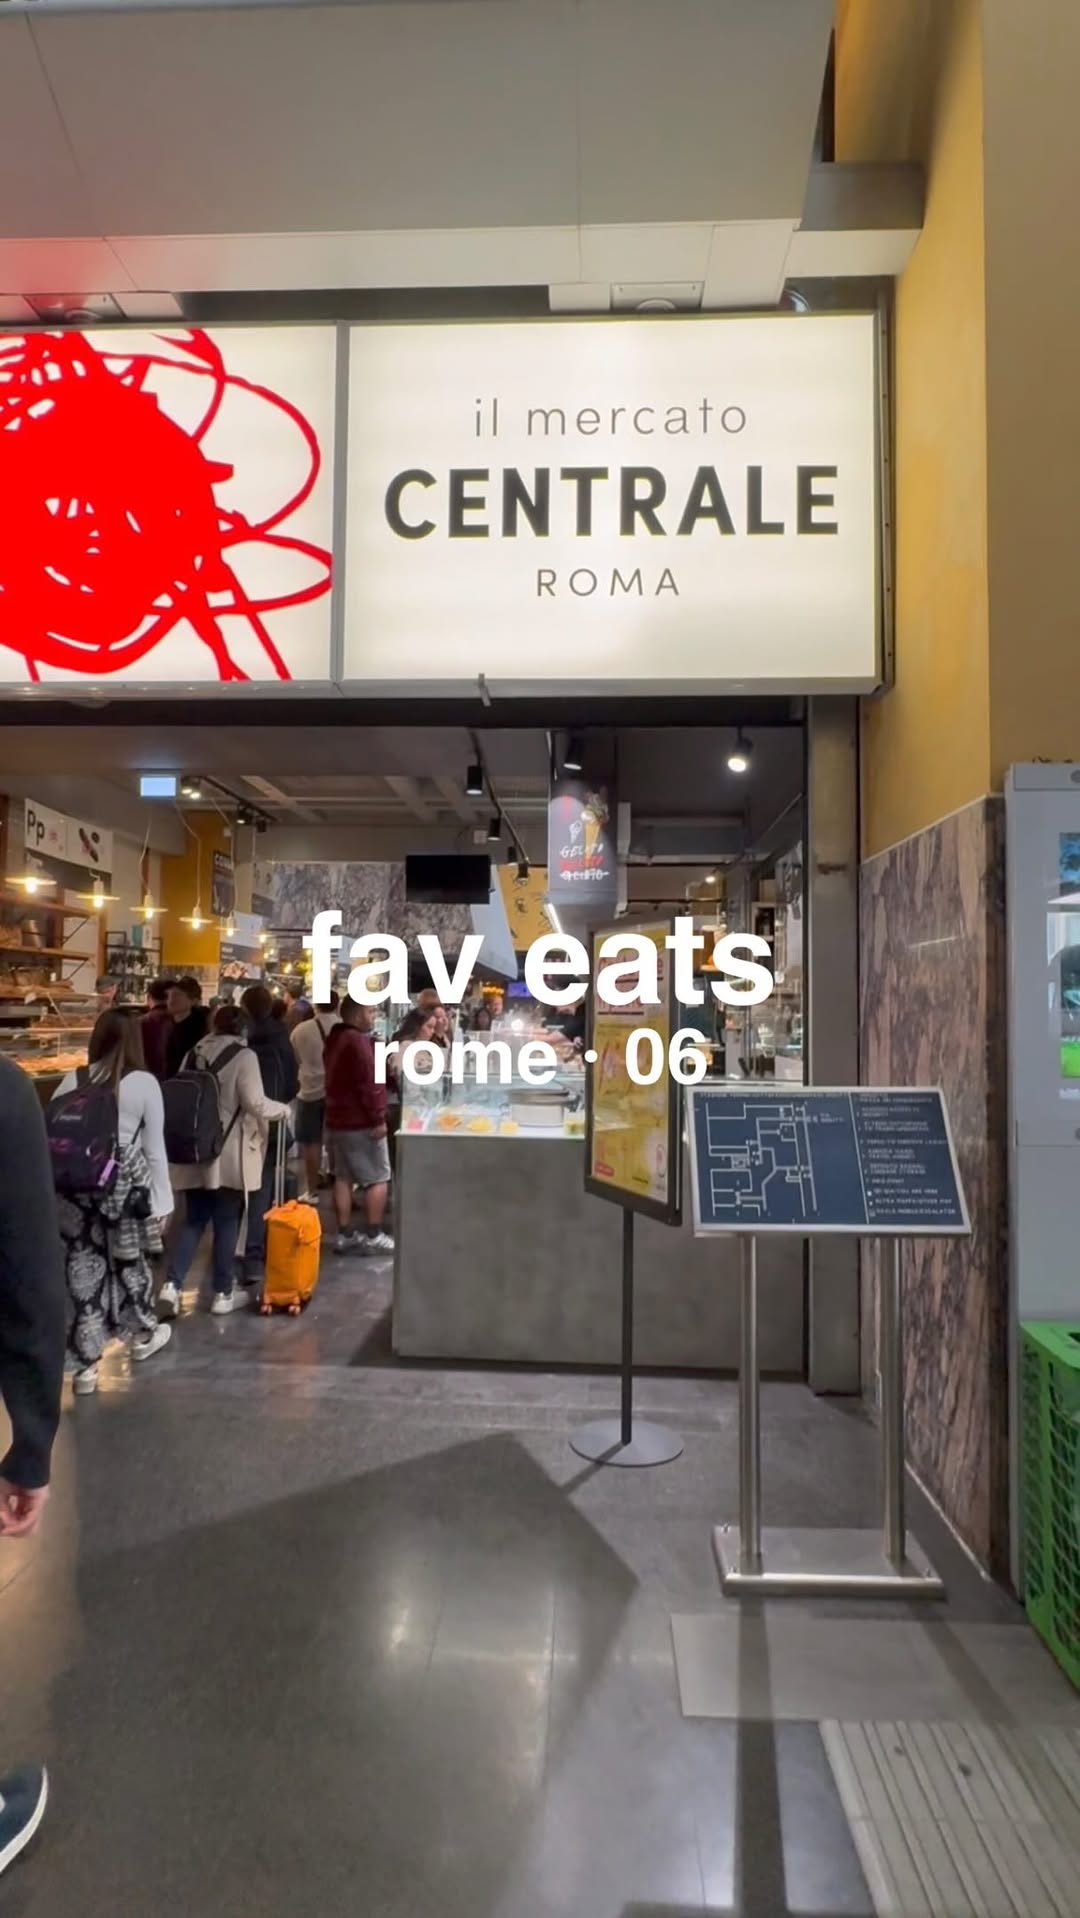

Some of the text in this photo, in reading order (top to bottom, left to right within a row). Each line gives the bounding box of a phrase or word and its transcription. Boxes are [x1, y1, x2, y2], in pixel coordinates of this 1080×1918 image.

[475, 397, 746, 437] il mercato
[384, 465, 839, 540] CENTRALE
[537, 567, 679, 597] ROMA
[27, 809, 45, 846] Pp
